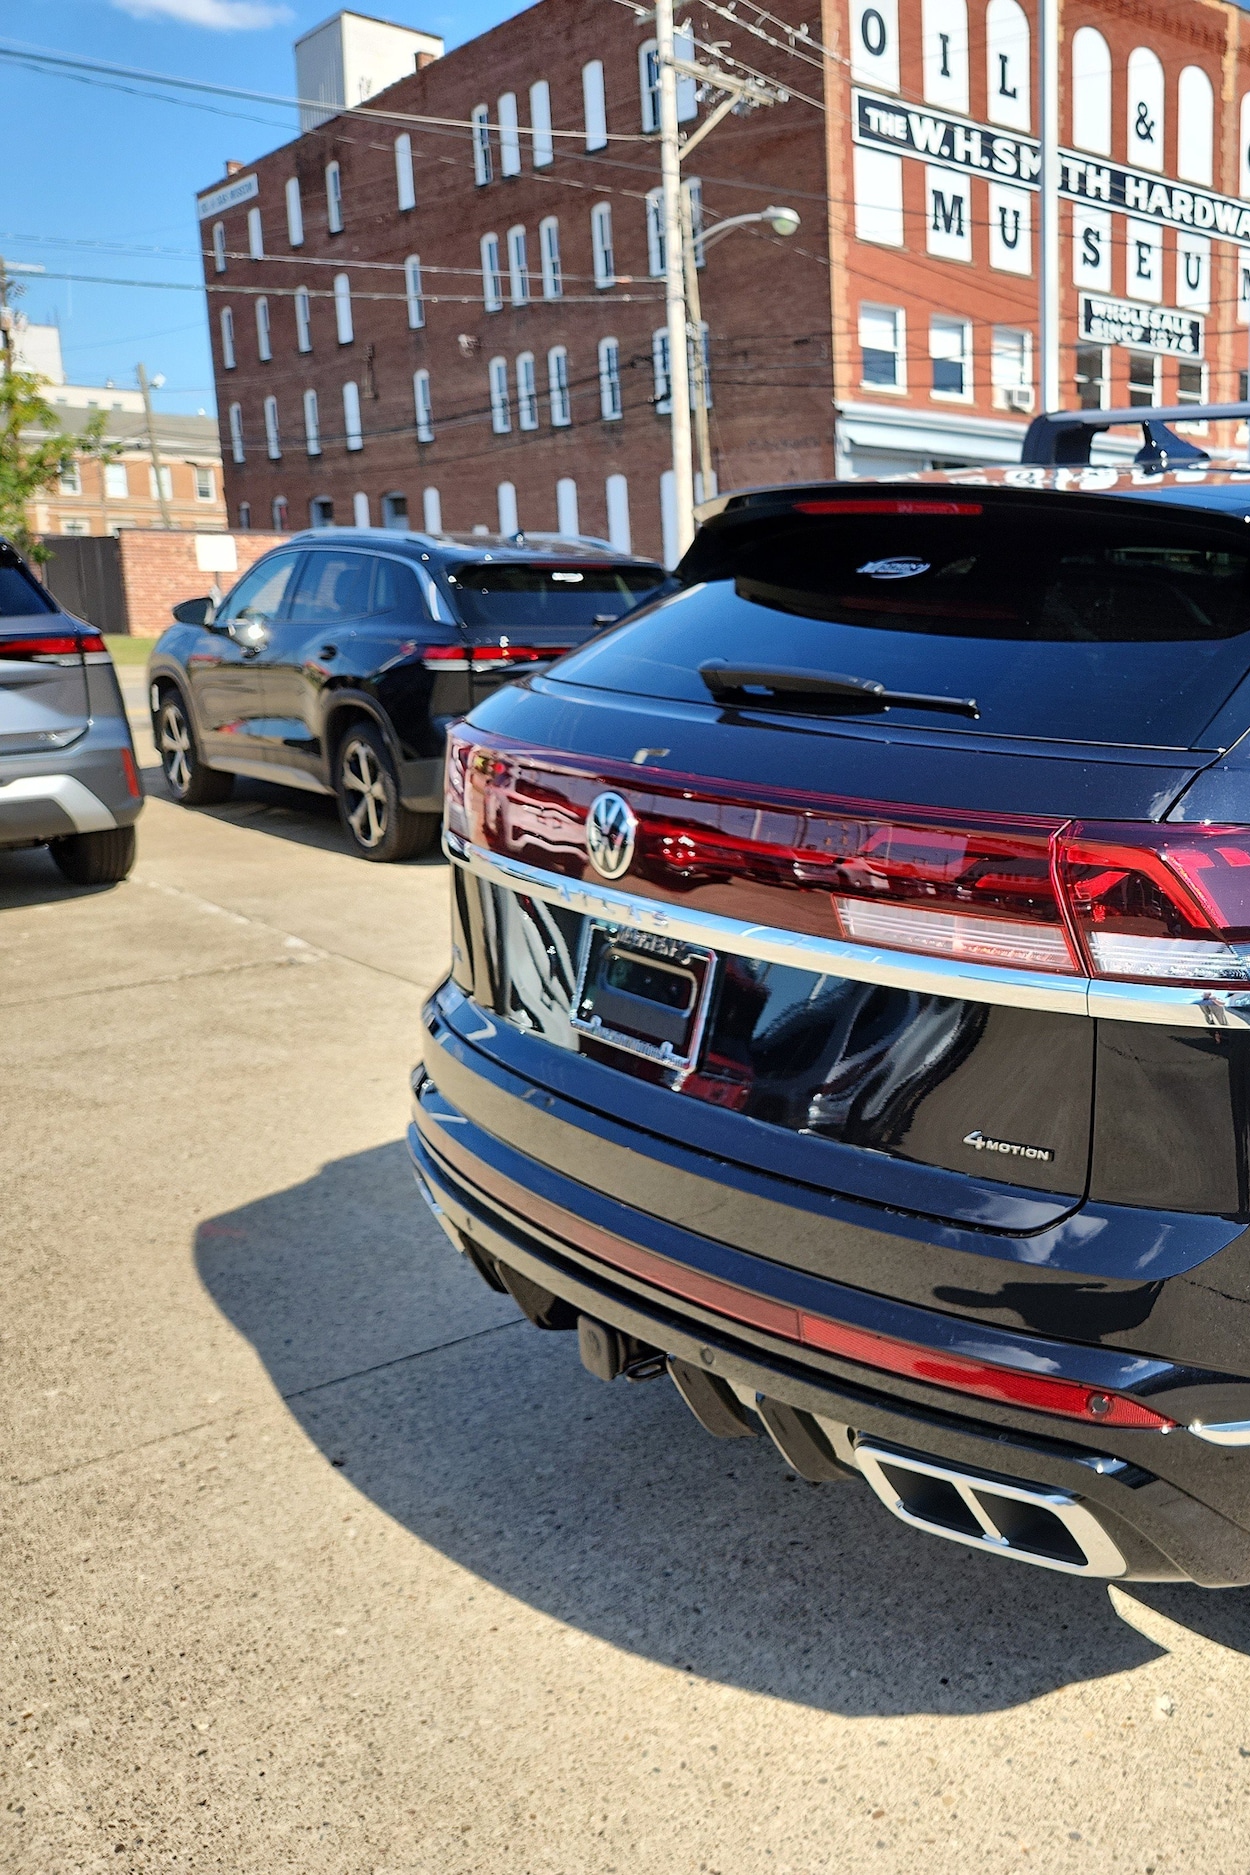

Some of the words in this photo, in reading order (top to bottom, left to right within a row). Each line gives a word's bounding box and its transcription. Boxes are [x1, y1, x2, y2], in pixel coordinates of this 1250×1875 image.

[861, 8, 1017, 99] OIL
[1134, 101, 1156, 143] &
[864, 106, 907, 140] THE
[1090, 300, 1192, 335] WHOLESALE
[1090, 316, 1145, 342] SINCE
[557, 883, 669, 929] ATLAS
[962, 1130, 1050, 1162] 4MOTION
